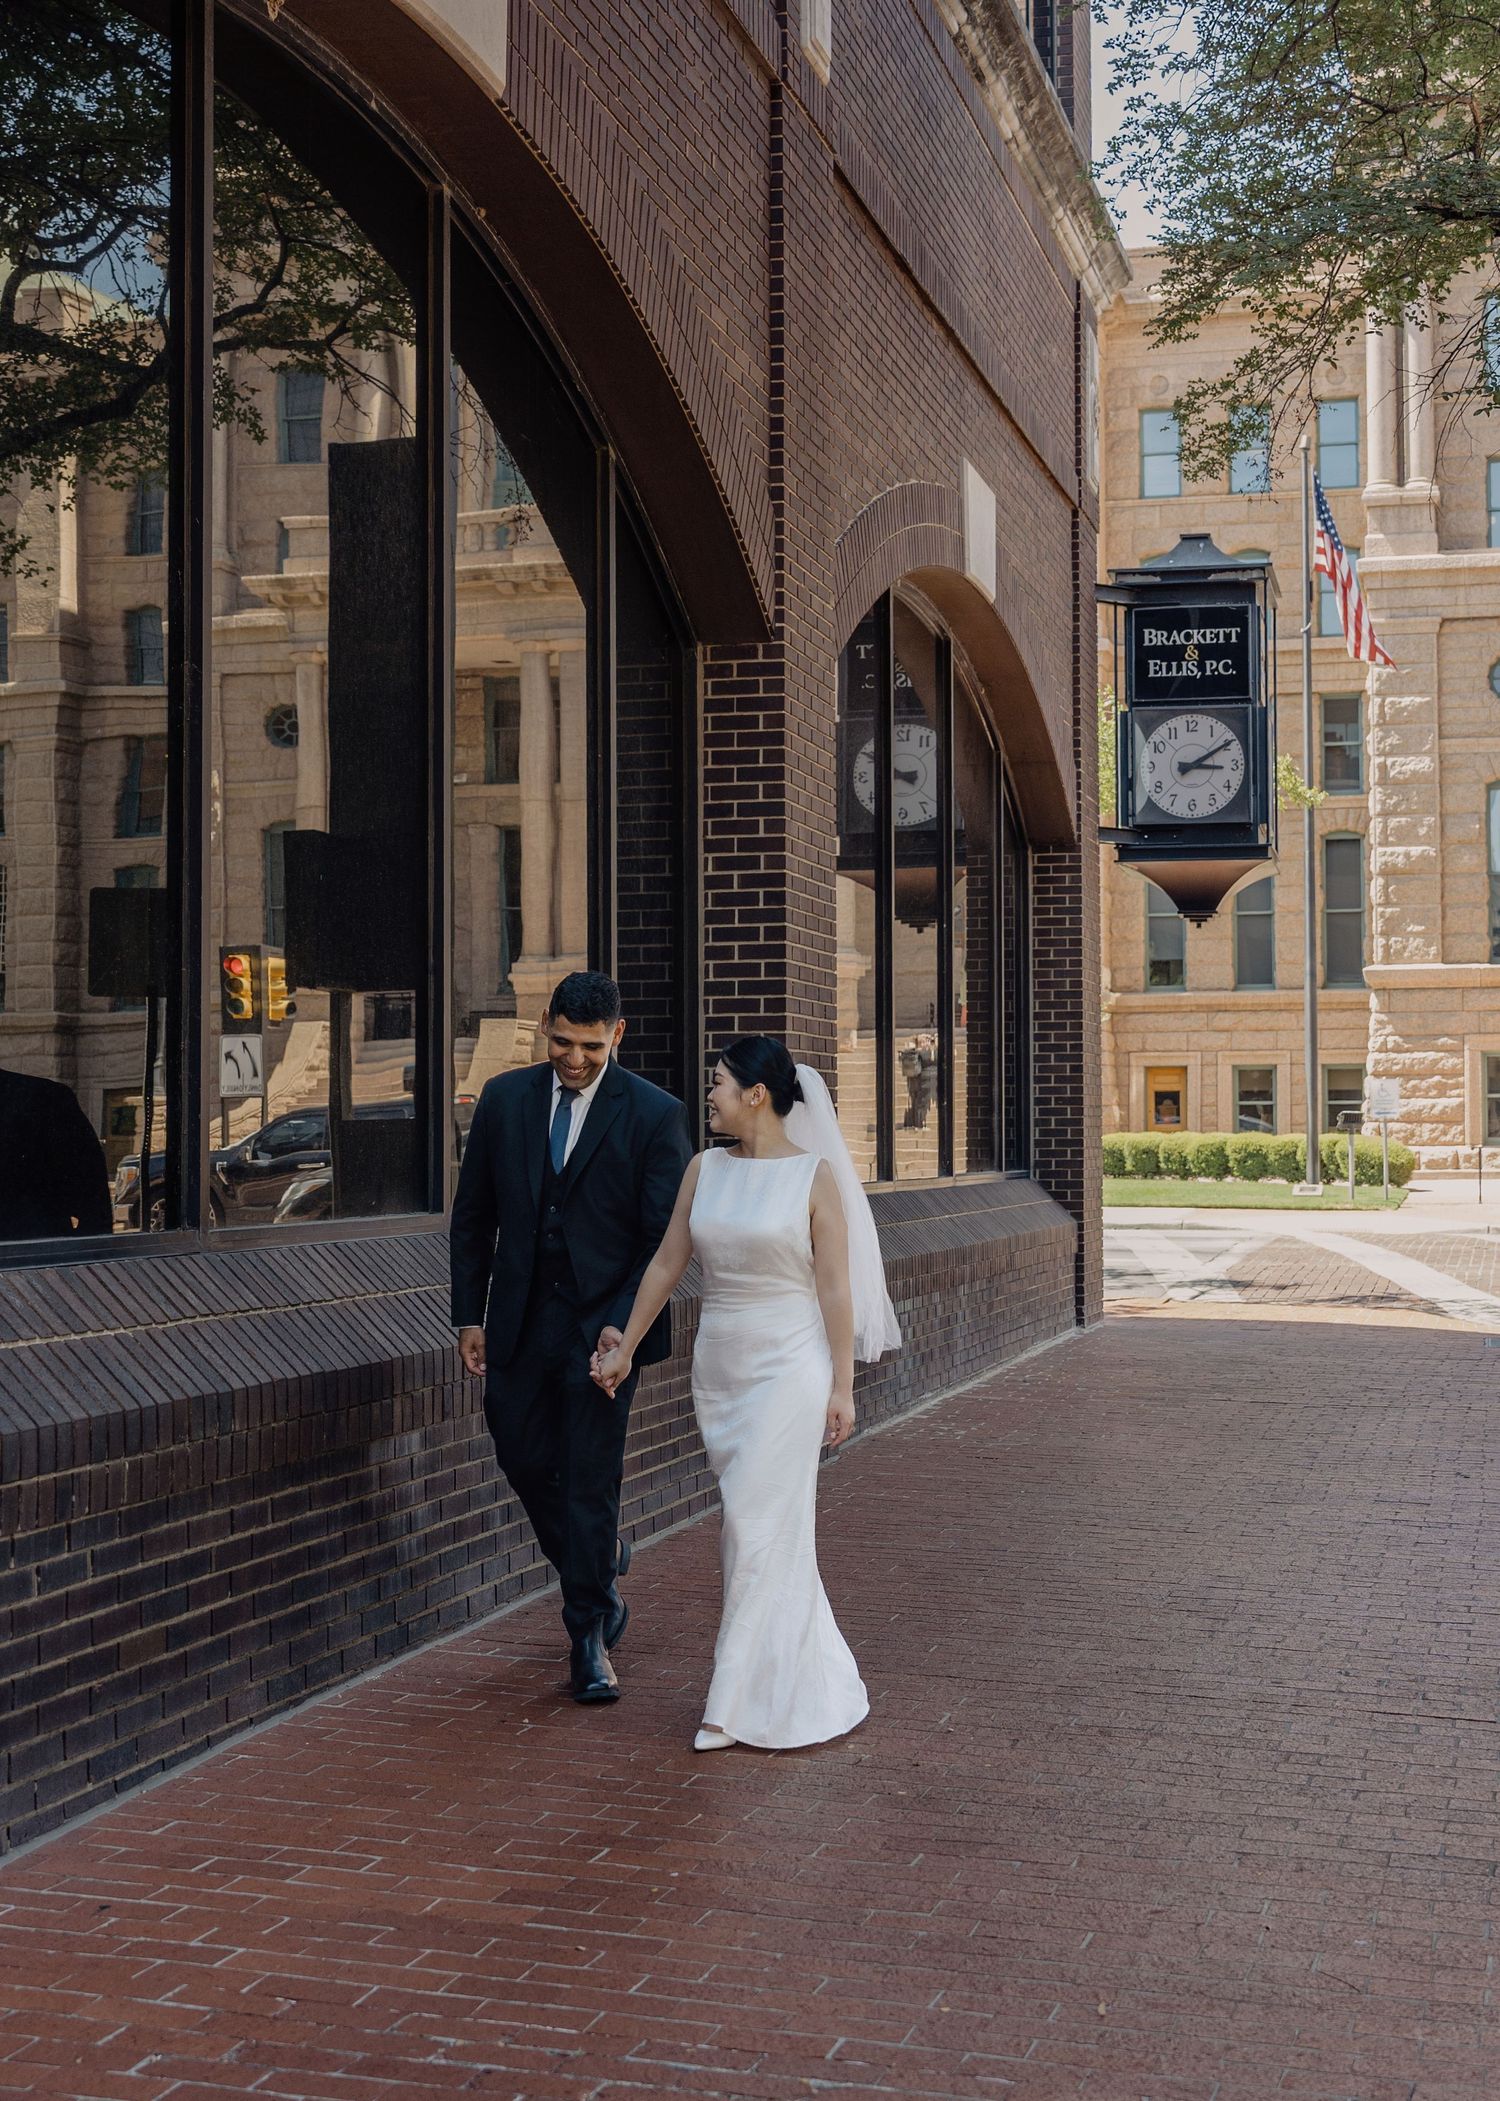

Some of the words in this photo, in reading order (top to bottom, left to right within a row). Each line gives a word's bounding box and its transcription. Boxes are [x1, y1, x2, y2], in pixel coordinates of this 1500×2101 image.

[1143, 628, 1240, 646] BRACKETT
[1185, 645, 1199, 661] &
[1148, 660, 1202, 679] ELLIS,
[1205, 659, 1237, 676] P.C.
[1186, 720, 1199, 733] 12
[1209, 725, 1214, 738] 1
[1168, 727, 1178, 740] 11
[1153, 741, 1166, 754] 10
[1147, 761, 1156, 774] 9
[1231, 759, 1239, 772] 3
[1154, 781, 1163, 794] 8
[1223, 780, 1232, 792] 4
[1168, 794, 1178, 807] 7
[1188, 799, 1197, 812] 6
[1208, 794, 1217, 807] 5
